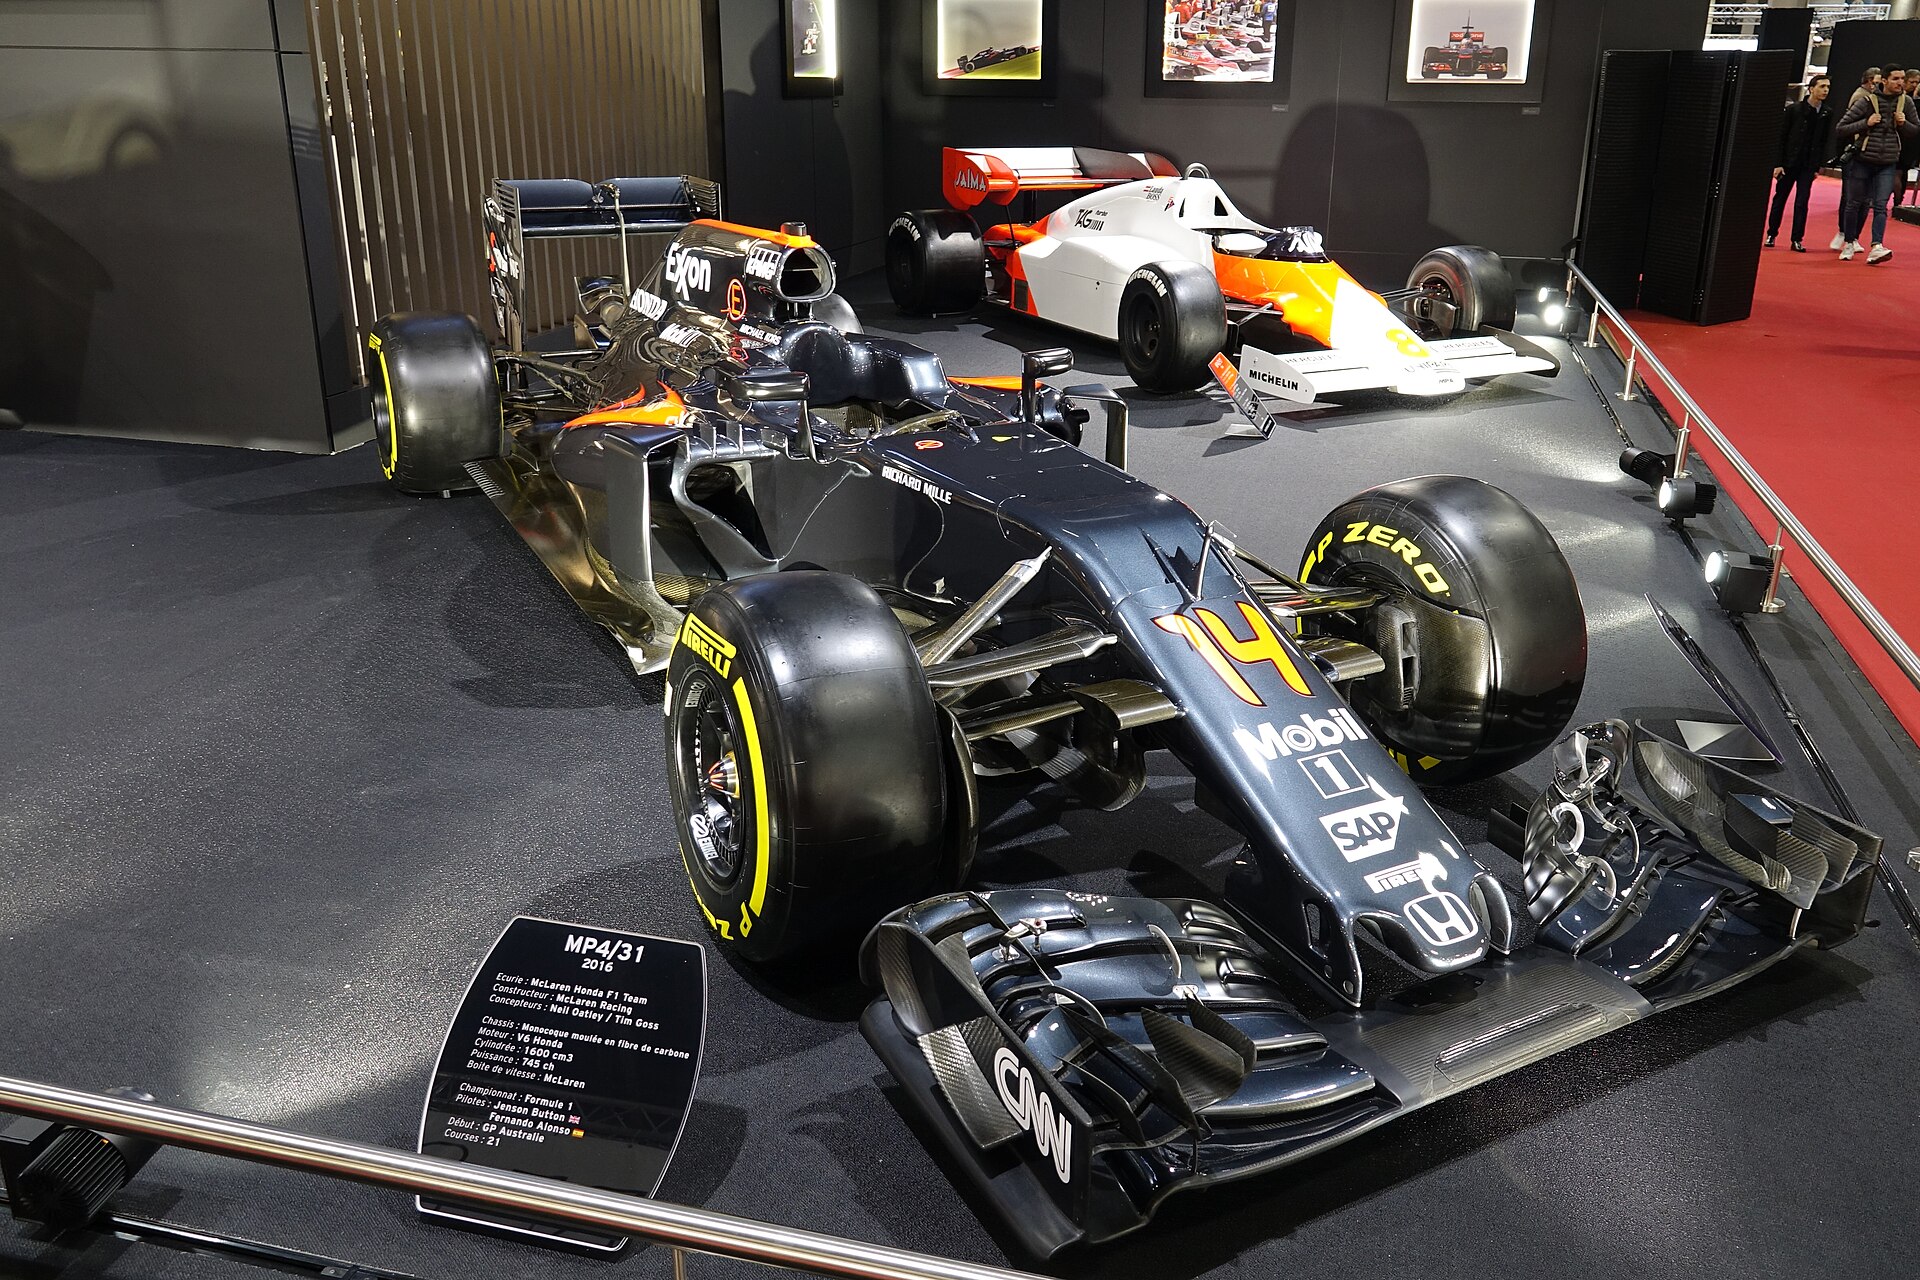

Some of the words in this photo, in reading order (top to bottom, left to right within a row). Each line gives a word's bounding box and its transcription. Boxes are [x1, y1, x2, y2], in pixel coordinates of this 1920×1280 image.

[629, 288, 668, 321] HONDA
[739, 323, 766, 340] MICHAEL
[763, 332, 782, 346] KORS
[1386, 329, 1430, 358] 8
[1249, 369, 1298, 391] MICHELIN
[882, 465, 922, 492] RICHARD
[922, 482, 953, 505] MILLE
[1317, 531, 1333, 563] P
[1342, 521, 1450, 595] ZERO
[680, 612, 737, 679] PIRELLI
[1150, 600, 1316, 707] 14
[1232, 708, 1369, 761] Mobil
[1330, 811, 1396, 851] SAP
[564, 934, 645, 963] MP4/31
[581, 958, 614, 973] 2016
[492, 983, 550, 1000] Constructeur
[555, 993, 597, 1008] McLaren
[599, 1001, 633, 1015] Racing
[495, 972, 524, 985] Ecurie
[530, 977, 572, 992] McLaren
[573, 984, 604, 998] Honda
[606, 990, 619, 1000] F1
[623, 993, 648, 1005] Team
[489, 994, 543, 1010] Concepteurs
[549, 1003, 570, 1015] Neil
[571, 1008, 604, 1022] Oatley
[615, 1015, 633, 1026] Tim
[635, 1019, 660, 1030] Goss
[474, 1037, 516, 1053] Cylindrée
[524, 1046, 550, 1058] 1600
[552, 1053, 574, 1062] cm3
[477, 1026, 509, 1039] Moteur
[517, 1032, 531, 1043] V6
[532, 1035, 564, 1049] Honda
[481, 1015, 515, 1029] Chassis
[521, 1022, 569, 1038] Monocoque
[571, 1032, 603, 1044] moulée
[604, 1037, 616, 1046] en
[617, 1039, 639, 1051] fibre
[641, 1044, 652, 1053] de
[654, 1046, 690, 1059] carbone
[470, 1048, 514, 1064] Puissance
[522, 1057, 541, 1068] 745
[542, 1062, 555, 1071] ch
[466, 1060, 491, 1071] Boite
[491, 1064, 503, 1074] de
[505, 1068, 536, 1080] vitesse
[543, 1073, 586, 1089] McLaren
[456, 1094, 487, 1108] Pilotes
[493, 1101, 529, 1115] Jenson
[531, 1109, 565, 1122] Button
[460, 1082, 517, 1101] Championnat
[524, 1094, 564, 1109] Formule
[568, 1102, 573, 1111] 1
[448, 1117, 475, 1130] Début
[482, 1123, 497, 1132] GP
[499, 1126, 545, 1143] Australie
[489, 1112, 534, 1128] Fernando
[536, 1121, 571, 1135] Alonso
[994, 1047, 1072, 1184] CNN
[444, 1128, 479, 1143] Courses
[486, 1136, 501, 1147] 21
